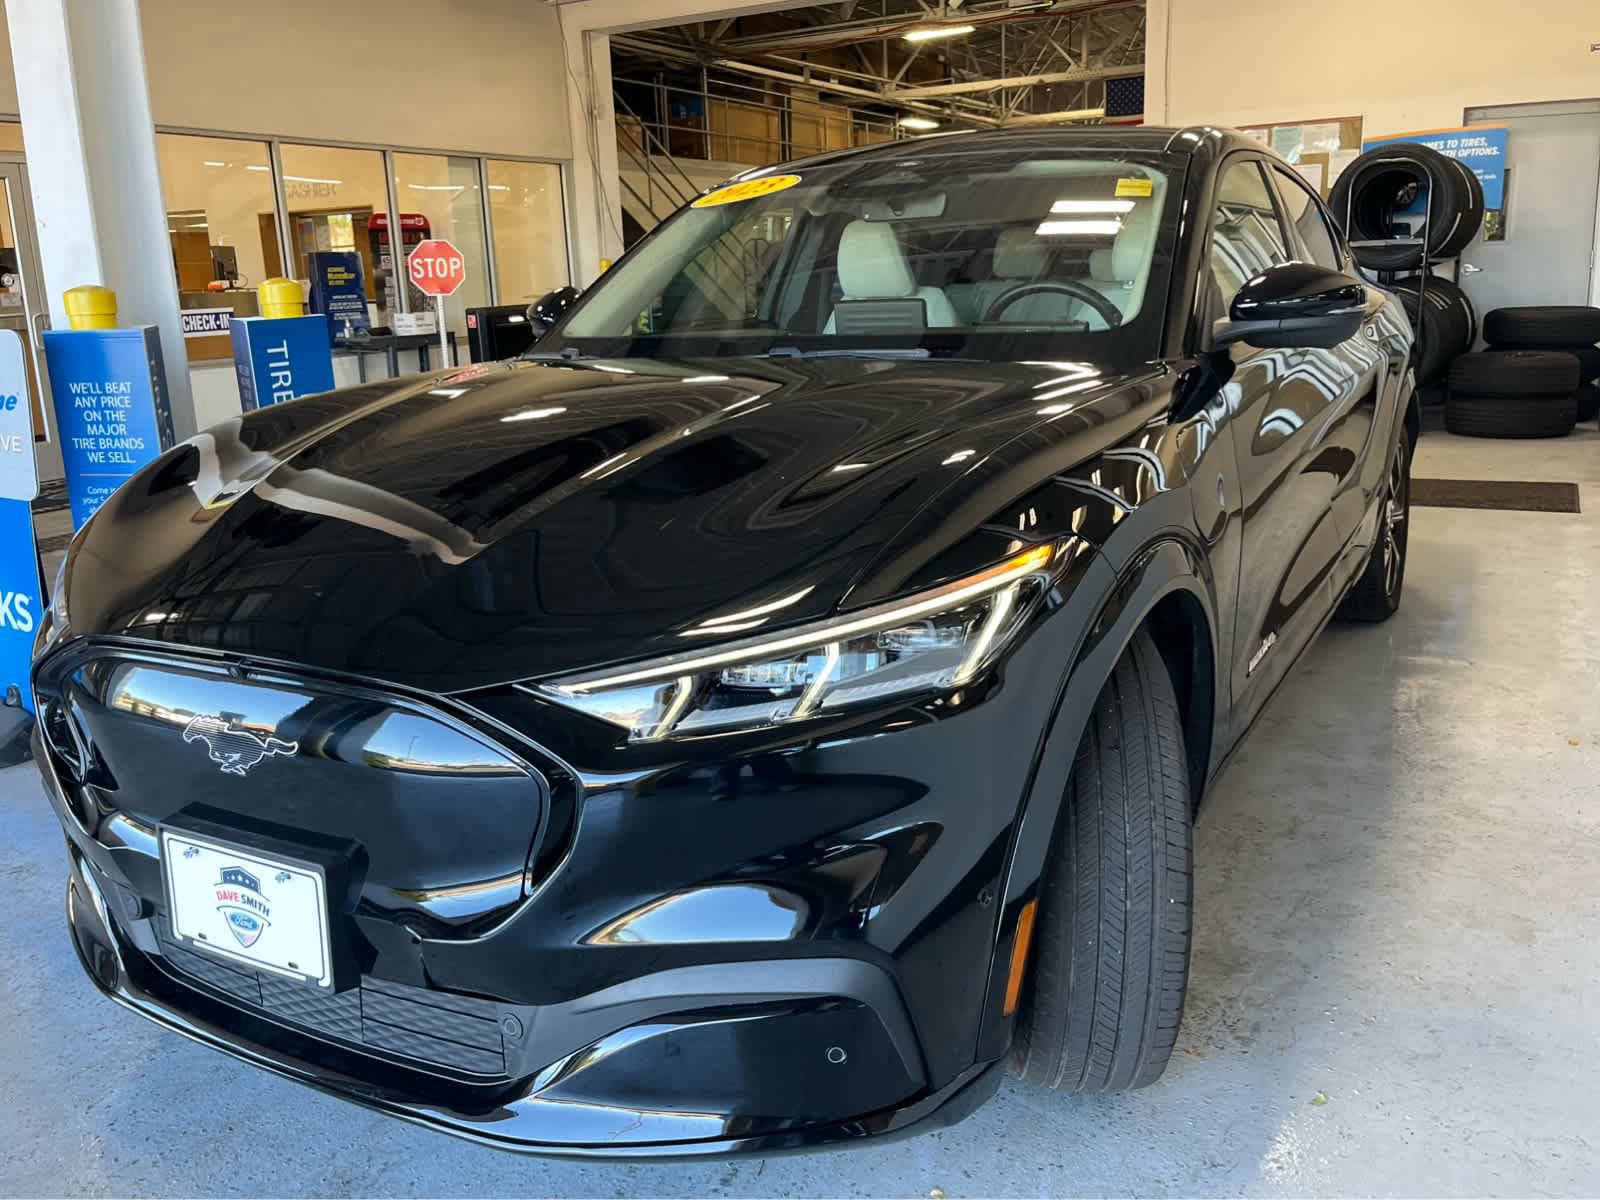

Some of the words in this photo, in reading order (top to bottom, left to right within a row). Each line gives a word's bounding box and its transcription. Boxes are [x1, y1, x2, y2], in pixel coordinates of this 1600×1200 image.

[1446, 139, 1458, 149] TO
[1460, 136, 1488, 148] TIRES,
[1458, 146, 1499, 157] OPTIONS.
[412, 256, 461, 279] STOP
[69, 382, 103, 394] WE'LL
[105, 382, 132, 394] BEAT
[75, 397, 99, 408] ANY
[101, 396, 132, 408] PRICE
[84, 410, 102, 421] ON
[104, 410, 127, 421] THE
[87, 424, 127, 436] MAJOR
[72, 438, 96, 449] TIRE
[99, 438, 145, 449] BRANDS
[87, 452, 106, 463] WE
[108, 452, 137, 463] SELL.
[216, 890, 241, 902] DAVE
[241, 894, 271, 917] SMITH
